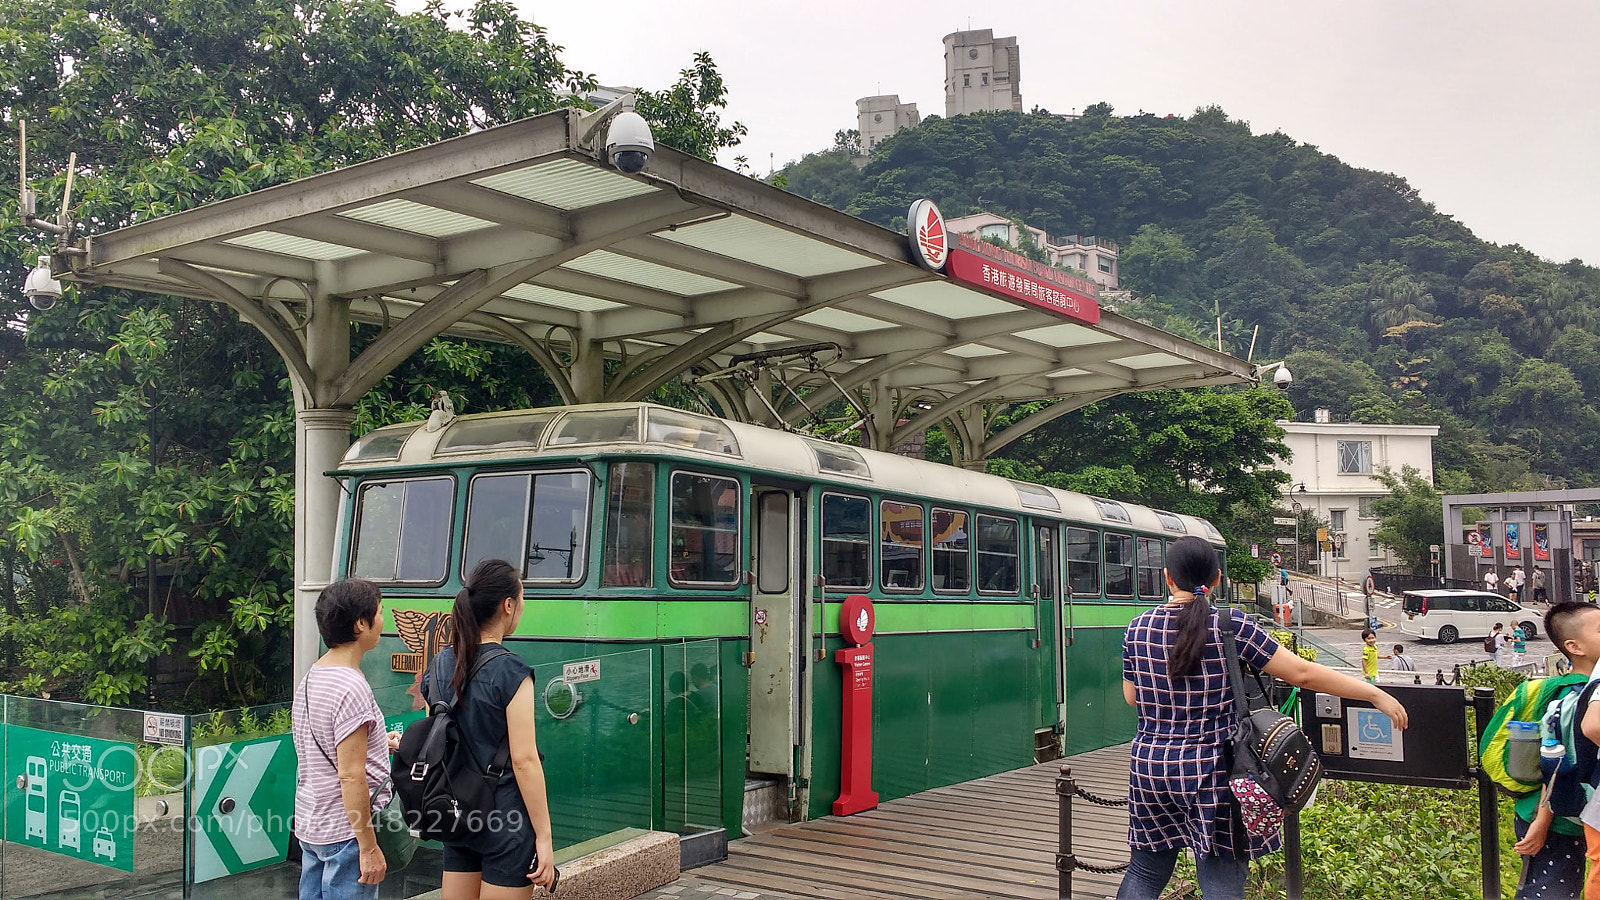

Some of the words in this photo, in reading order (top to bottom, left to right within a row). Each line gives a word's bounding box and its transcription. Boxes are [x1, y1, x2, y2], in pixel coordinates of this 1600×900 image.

[957, 230, 981, 253] HONG
[981, 240, 1003, 261] KONG
[1002, 248, 1032, 271] TOURISM
[1032, 260, 1053, 281] BOARD
[1053, 269, 1076, 289] VISITOR
[1075, 278, 1096, 297] CENTRE
[982, 263, 1080, 313] 香港旅遊發展局旅客諮詢中心
[391, 654, 422, 671] CELEBRATE
[566, 664, 590, 676] 小心地滑
[50, 740, 92, 763] 公共交通
[49, 759, 77, 775] PUBLIC
[79, 764, 126, 784] TRANSPORT
